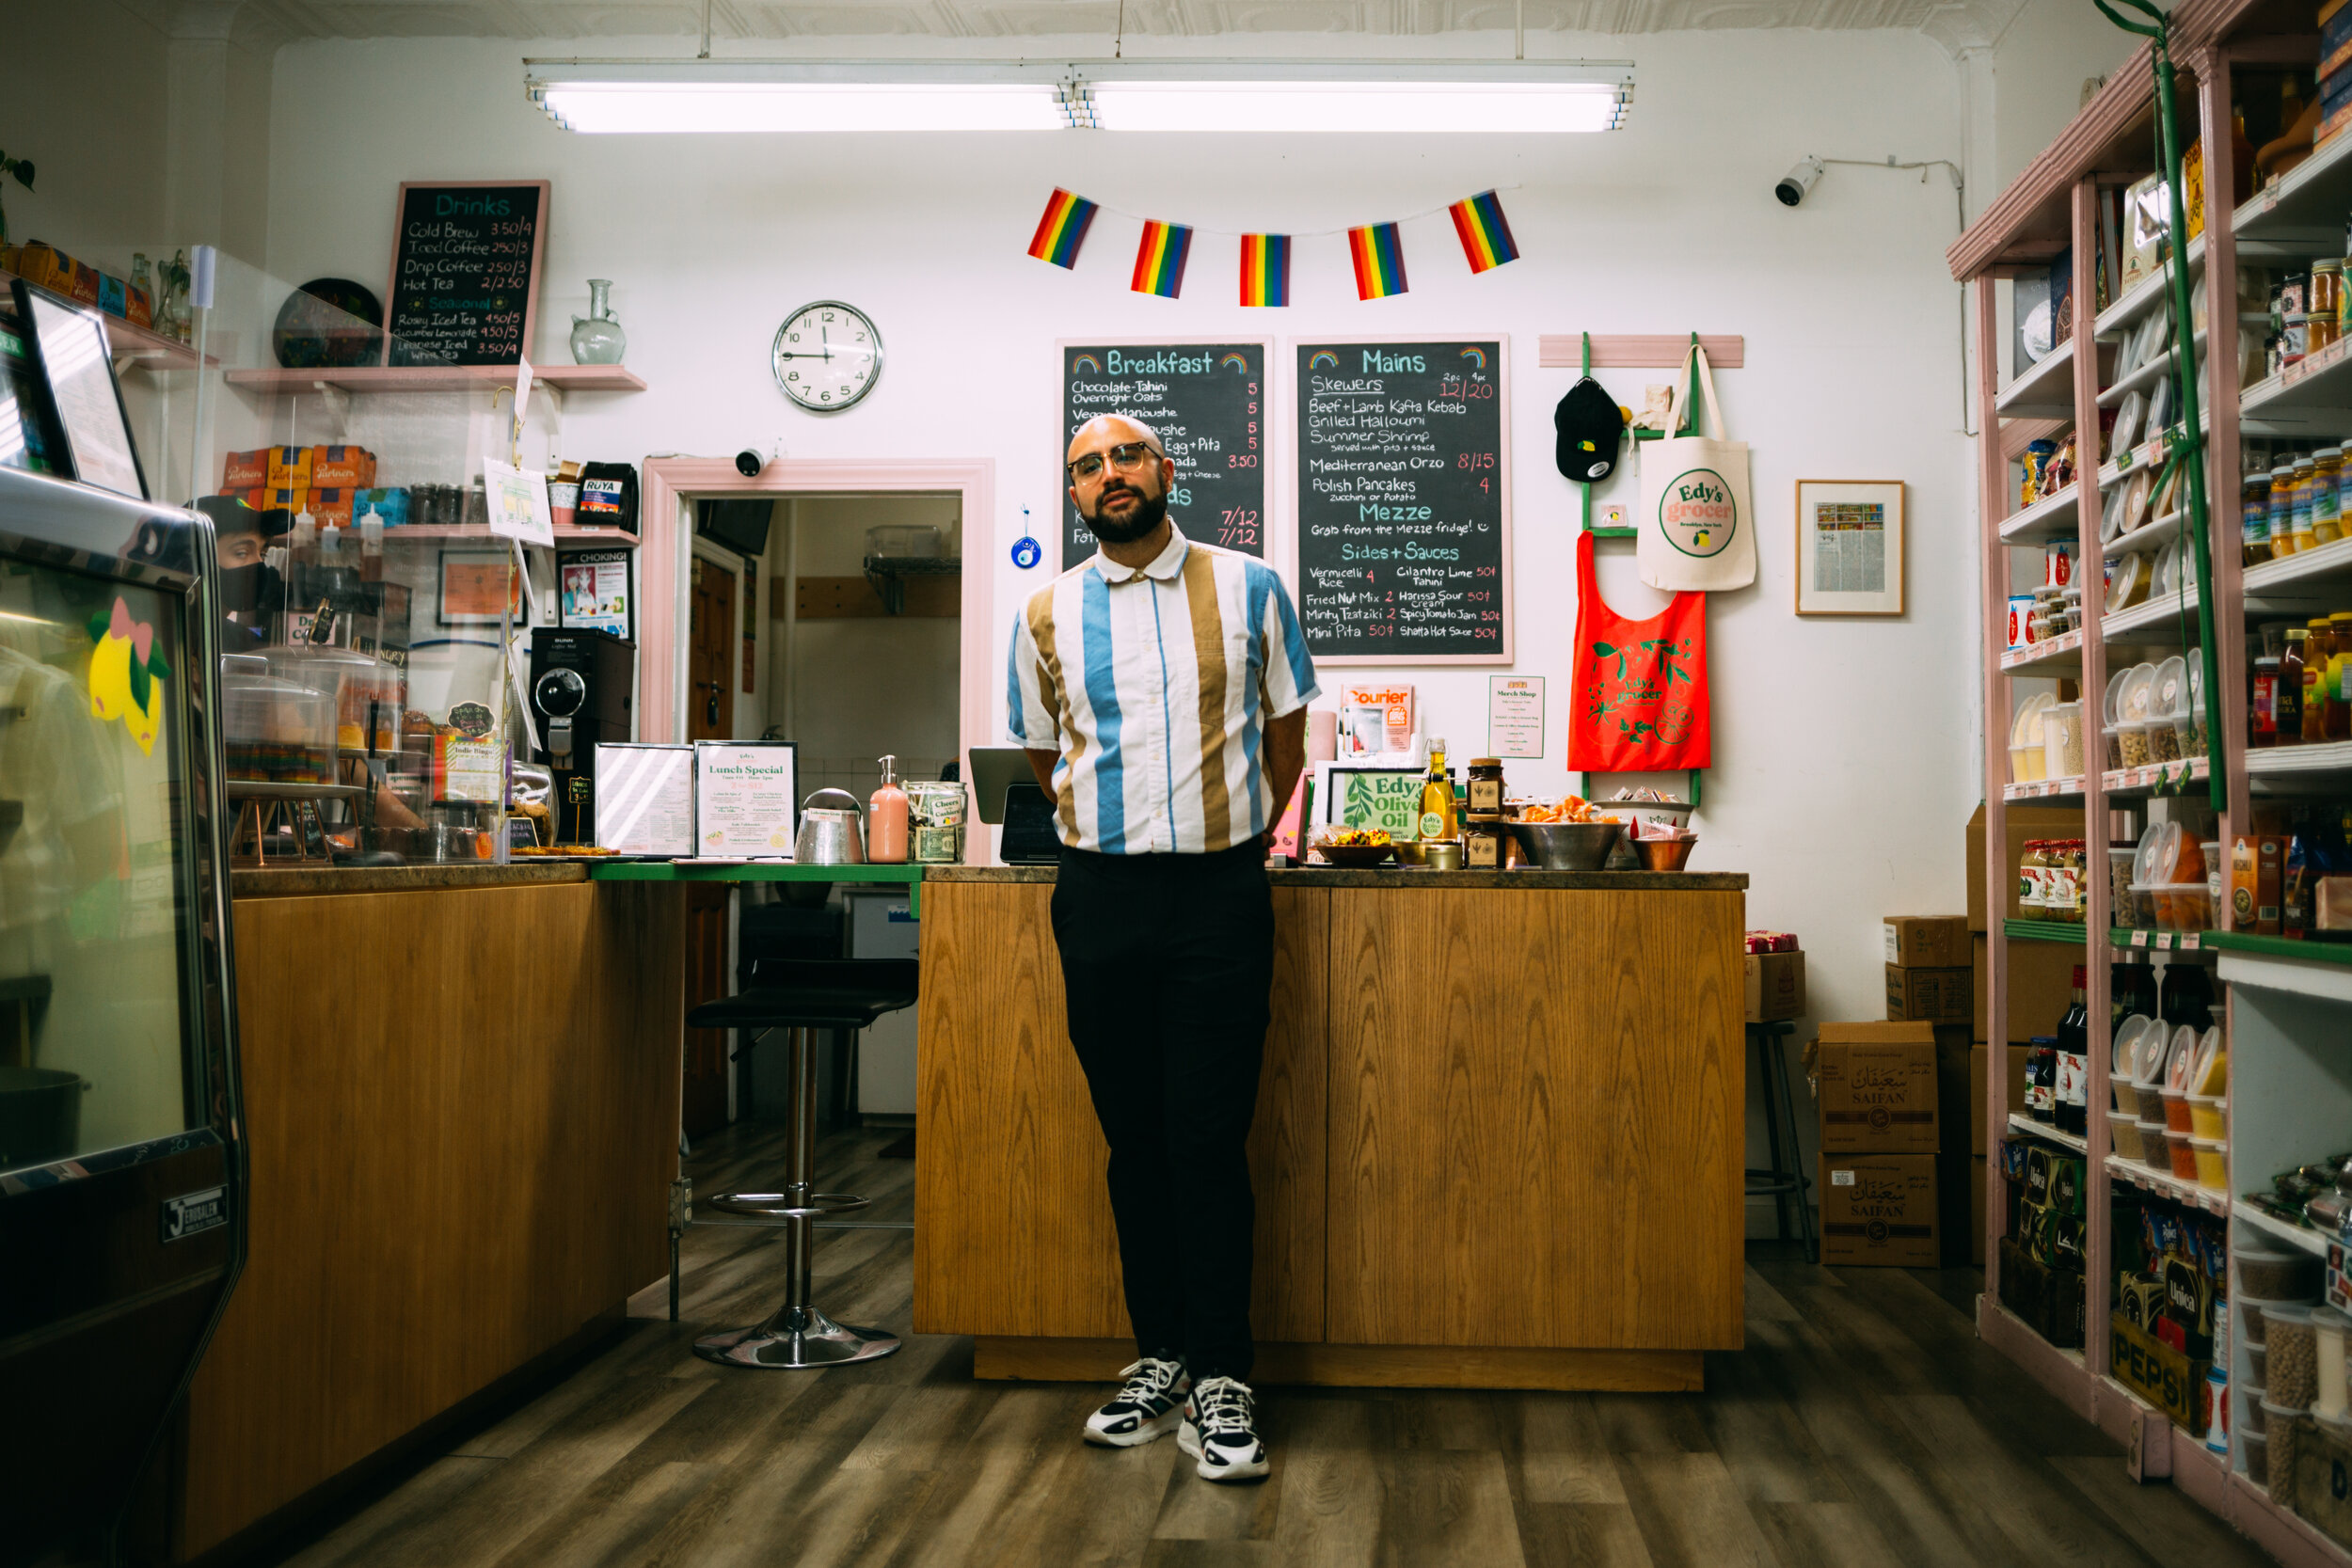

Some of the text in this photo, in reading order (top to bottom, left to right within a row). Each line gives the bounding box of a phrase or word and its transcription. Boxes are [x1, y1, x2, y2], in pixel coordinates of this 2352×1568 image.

[436, 195, 511, 216] Drinks
[408, 222, 479, 238] Cold Brew
[408, 239, 489, 255] Iced Coffee
[405, 259, 484, 277] Drip Coffee
[403, 277, 453, 291] Hot Tea
[429, 296, 490, 310] Seasonal
[431, 312, 457, 325] Iced
[460, 312, 476, 325] Tea
[804, 318, 811, 328] 11
[821, 312, 834, 322] 12
[789, 333, 800, 342] 10
[855, 332, 866, 341] 2
[444, 341, 468, 350] Iced
[439, 350, 458, 359] Tea
[1363, 349, 1426, 373] Mains
[1107, 349, 1213, 375] Breakfast
[788, 372, 799, 381] 8
[854, 372, 864, 380] 4
[803, 386, 811, 396] 7
[840, 386, 850, 395] 5
[1072, 381, 1258, 395] Chocolate-Tahini 5
[1311, 375, 1493, 402] Skewers 12/20
[820, 391, 831, 401] 6
[1073, 392, 1163, 405] Overnight Oats
[1248, 403, 1258, 414] 5
[1309, 399, 1343, 413] Beef
[1352, 399, 1385, 413] Lamb
[1390, 400, 1422, 413] Kafta
[1427, 400, 1466, 414] Kebab
[1248, 422, 1258, 434] 5
[1309, 414, 1425, 428] Grilled Halloumi
[1311, 430, 1429, 443] Summer Shrimp
[1166, 437, 1188, 454] Egg
[1198, 437, 1220, 451] Pita
[1248, 437, 1258, 450] 5
[1384, 443, 1401, 453] pita
[1411, 443, 1436, 451] sauce
[1228, 454, 1258, 468] 3.50
[1310, 452, 1494, 473] Mediterranean Orzo 8/15
[229, 467, 262, 481] Partners
[317, 463, 355, 479] Partners
[1174, 470, 1186, 480] Egg
[1313, 477, 1489, 494] Polish Pancakes 4
[1678, 482, 1723, 503] Edy's
[310, 503, 348, 519] Partners
[1221, 506, 1259, 527] 7/12
[1359, 503, 1432, 522] Mezze
[1667, 501, 1732, 522] grocer
[1311, 519, 1472, 536] Grab from the Mezze fridge!
[1217, 527, 1258, 546] 7/12
[580, 551, 627, 562] CHOKING!
[1342, 544, 1389, 561] Sides
[1404, 541, 1459, 561] Sauces
[1310, 567, 1362, 578] Vermicelli
[1366, 570, 1375, 584] 4
[1396, 566, 1444, 577] Cilantro
[1449, 566, 1472, 578] Lime
[1319, 578, 1344, 588] Rice
[1307, 593, 1335, 607] Fried
[1338, 592, 1357, 603] Nut
[1359, 593, 1379, 603] Mix
[1385, 591, 1394, 603] 2
[1399, 592, 1436, 601] Harissa
[1438, 591, 1463, 601] Sour
[1307, 610, 1339, 626] Minty
[1340, 607, 1383, 620] Tzatziki
[1387, 608, 1396, 620] 2
[1400, 609, 1426, 622] Spicy
[1425, 609, 1456, 619] Tomato
[1457, 609, 1477, 620] Jam
[1307, 626, 1332, 639] Mini
[1337, 625, 1361, 638] Pita
[1400, 626, 1429, 636] Shatta
[1431, 626, 1447, 637] Hot
[1450, 626, 1471, 636] Sauce
[1625, 677, 1655, 690] Edy's
[1617, 689, 1662, 705] grocer
[745, 766, 783, 775] Special
[1375, 797, 1420, 811] Olive
[1381, 813, 1407, 827] Oil
[1852, 1093, 1905, 1104] SAIFAN
[1851, 1206, 1904, 1217] SAIFAN
[2169, 1279, 2196, 1312] Unica
[2115, 1333, 2186, 1415] PEPSI
